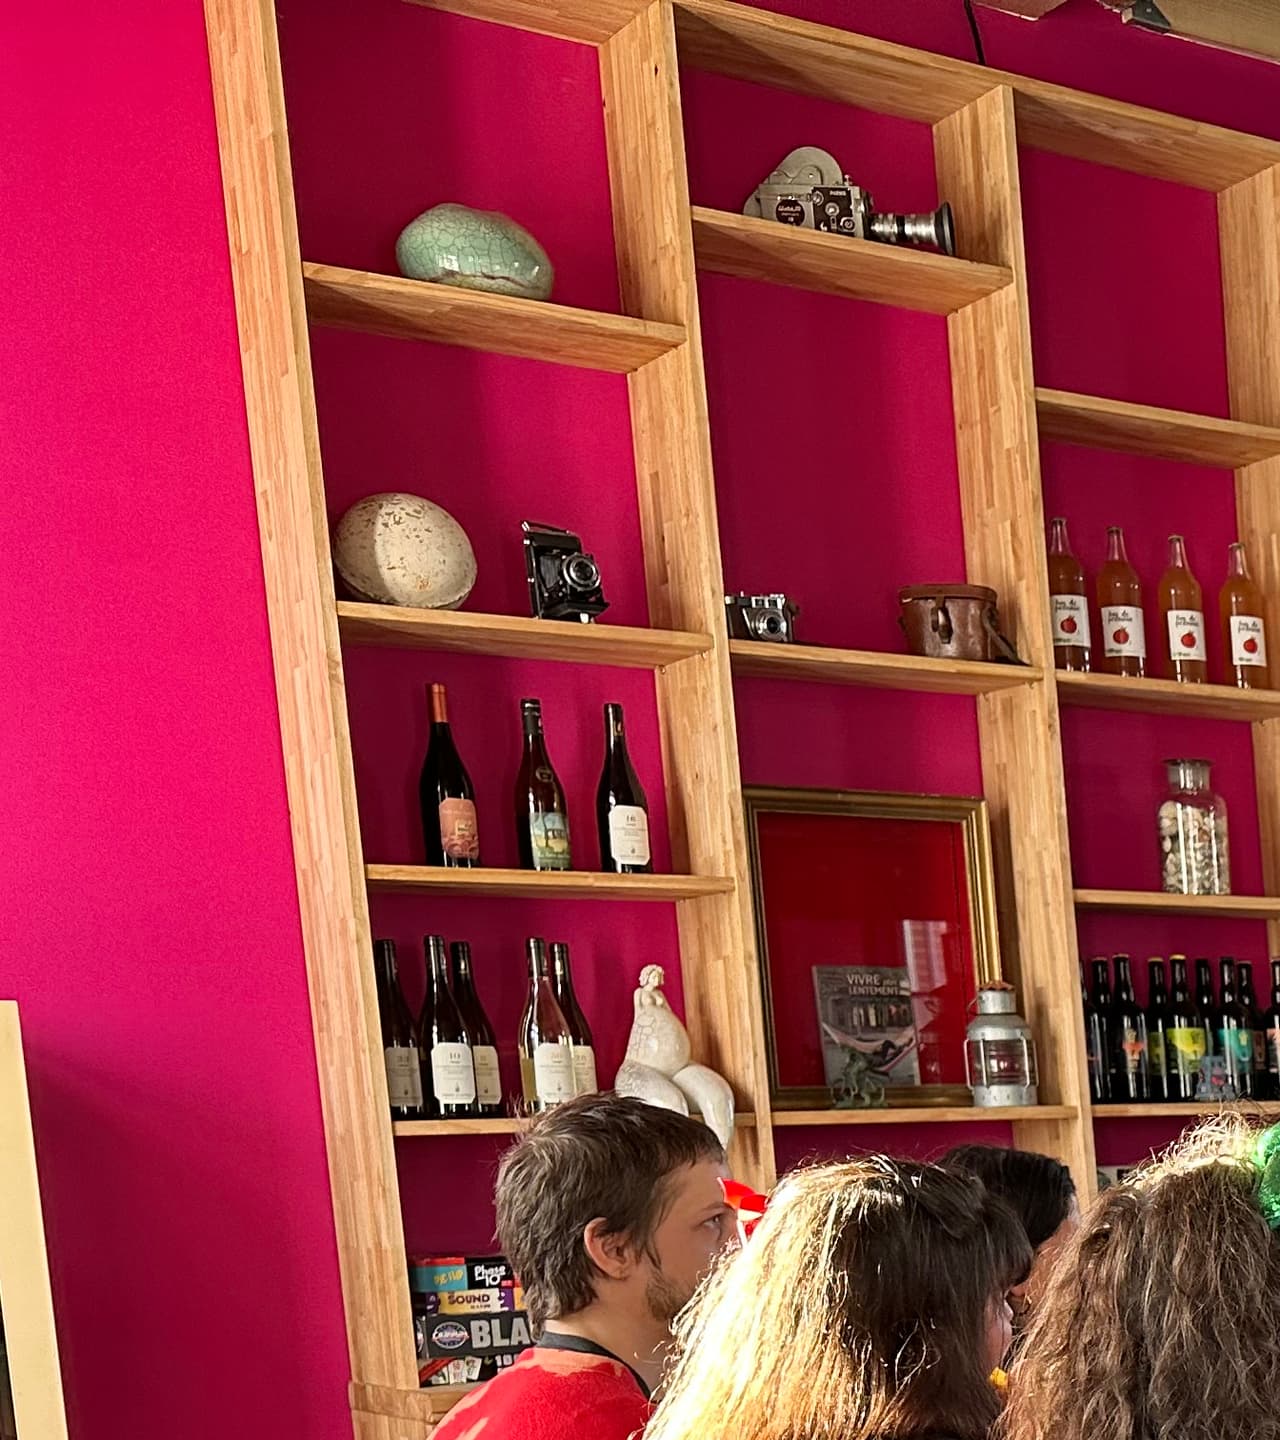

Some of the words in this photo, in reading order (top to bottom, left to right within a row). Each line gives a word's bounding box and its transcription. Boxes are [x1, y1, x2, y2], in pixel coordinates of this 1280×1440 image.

[846, 973, 881, 986] VIVRE
[474, 1264, 506, 1281] Phase
[485, 1274, 501, 1287] 10
[470, 1317, 531, 1349] BLA
